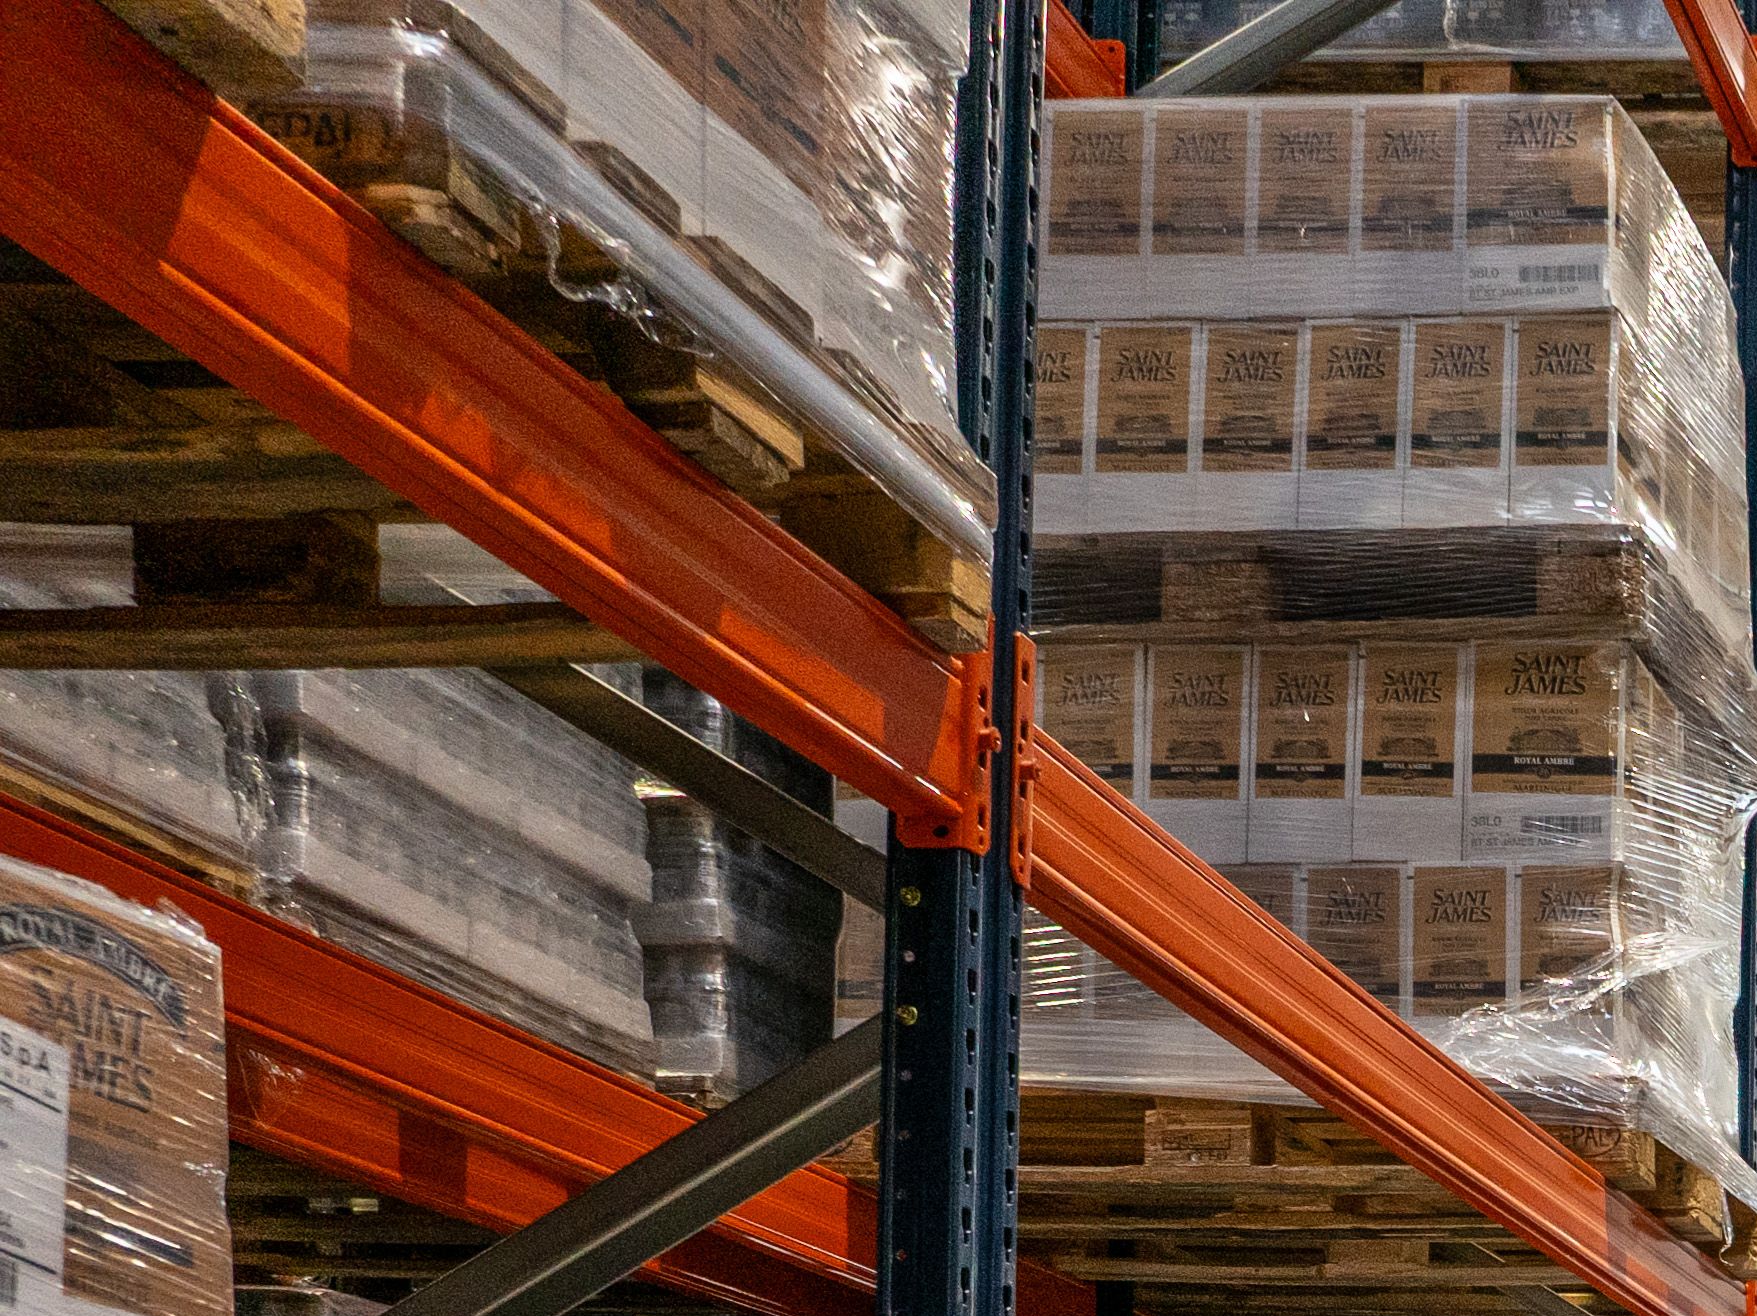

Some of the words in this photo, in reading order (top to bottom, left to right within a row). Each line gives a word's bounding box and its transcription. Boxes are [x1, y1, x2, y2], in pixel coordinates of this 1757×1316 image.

[1537, 342, 1594, 359] SAINT
[1529, 359, 1595, 377] JAMES
[1513, 652, 1585, 675] SAINT
[1385, 669, 1441, 687] SAINT
[1505, 675, 1586, 695] JAMES
[1378, 687, 1442, 703] JAMES
[1514, 757, 1541, 765] ROYAL
[1435, 889, 1492, 905] SAINT
[1426, 905, 1492, 923] JAMES
